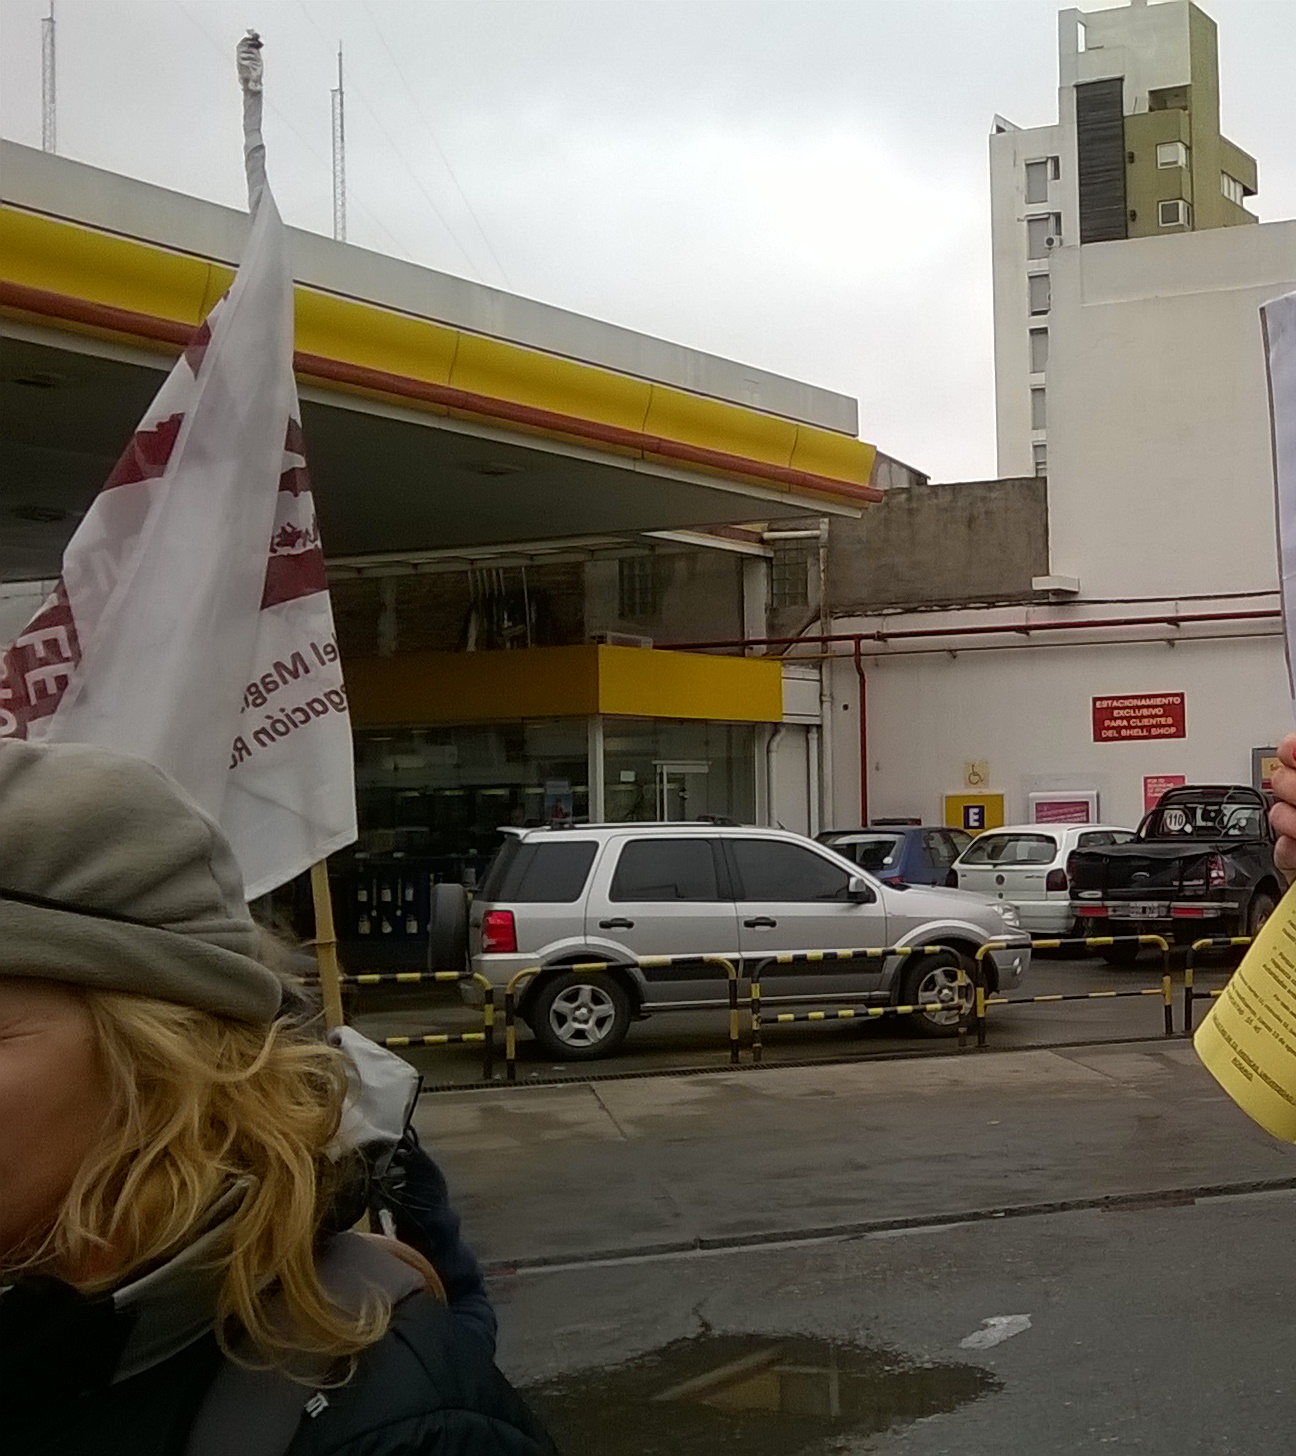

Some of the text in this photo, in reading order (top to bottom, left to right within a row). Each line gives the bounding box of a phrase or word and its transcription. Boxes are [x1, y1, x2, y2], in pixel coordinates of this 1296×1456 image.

[1095, 696, 1181, 709] ESTACIONAMIENTO
[1113, 707, 1164, 718] EXCLUSIVO
[1104, 717, 1173, 728] PARA CLIENTES
[1101, 726, 1177, 738] DEL SHELL SHOP
[968, 807, 980, 827] E
[1168, 813, 1184, 827] 110
